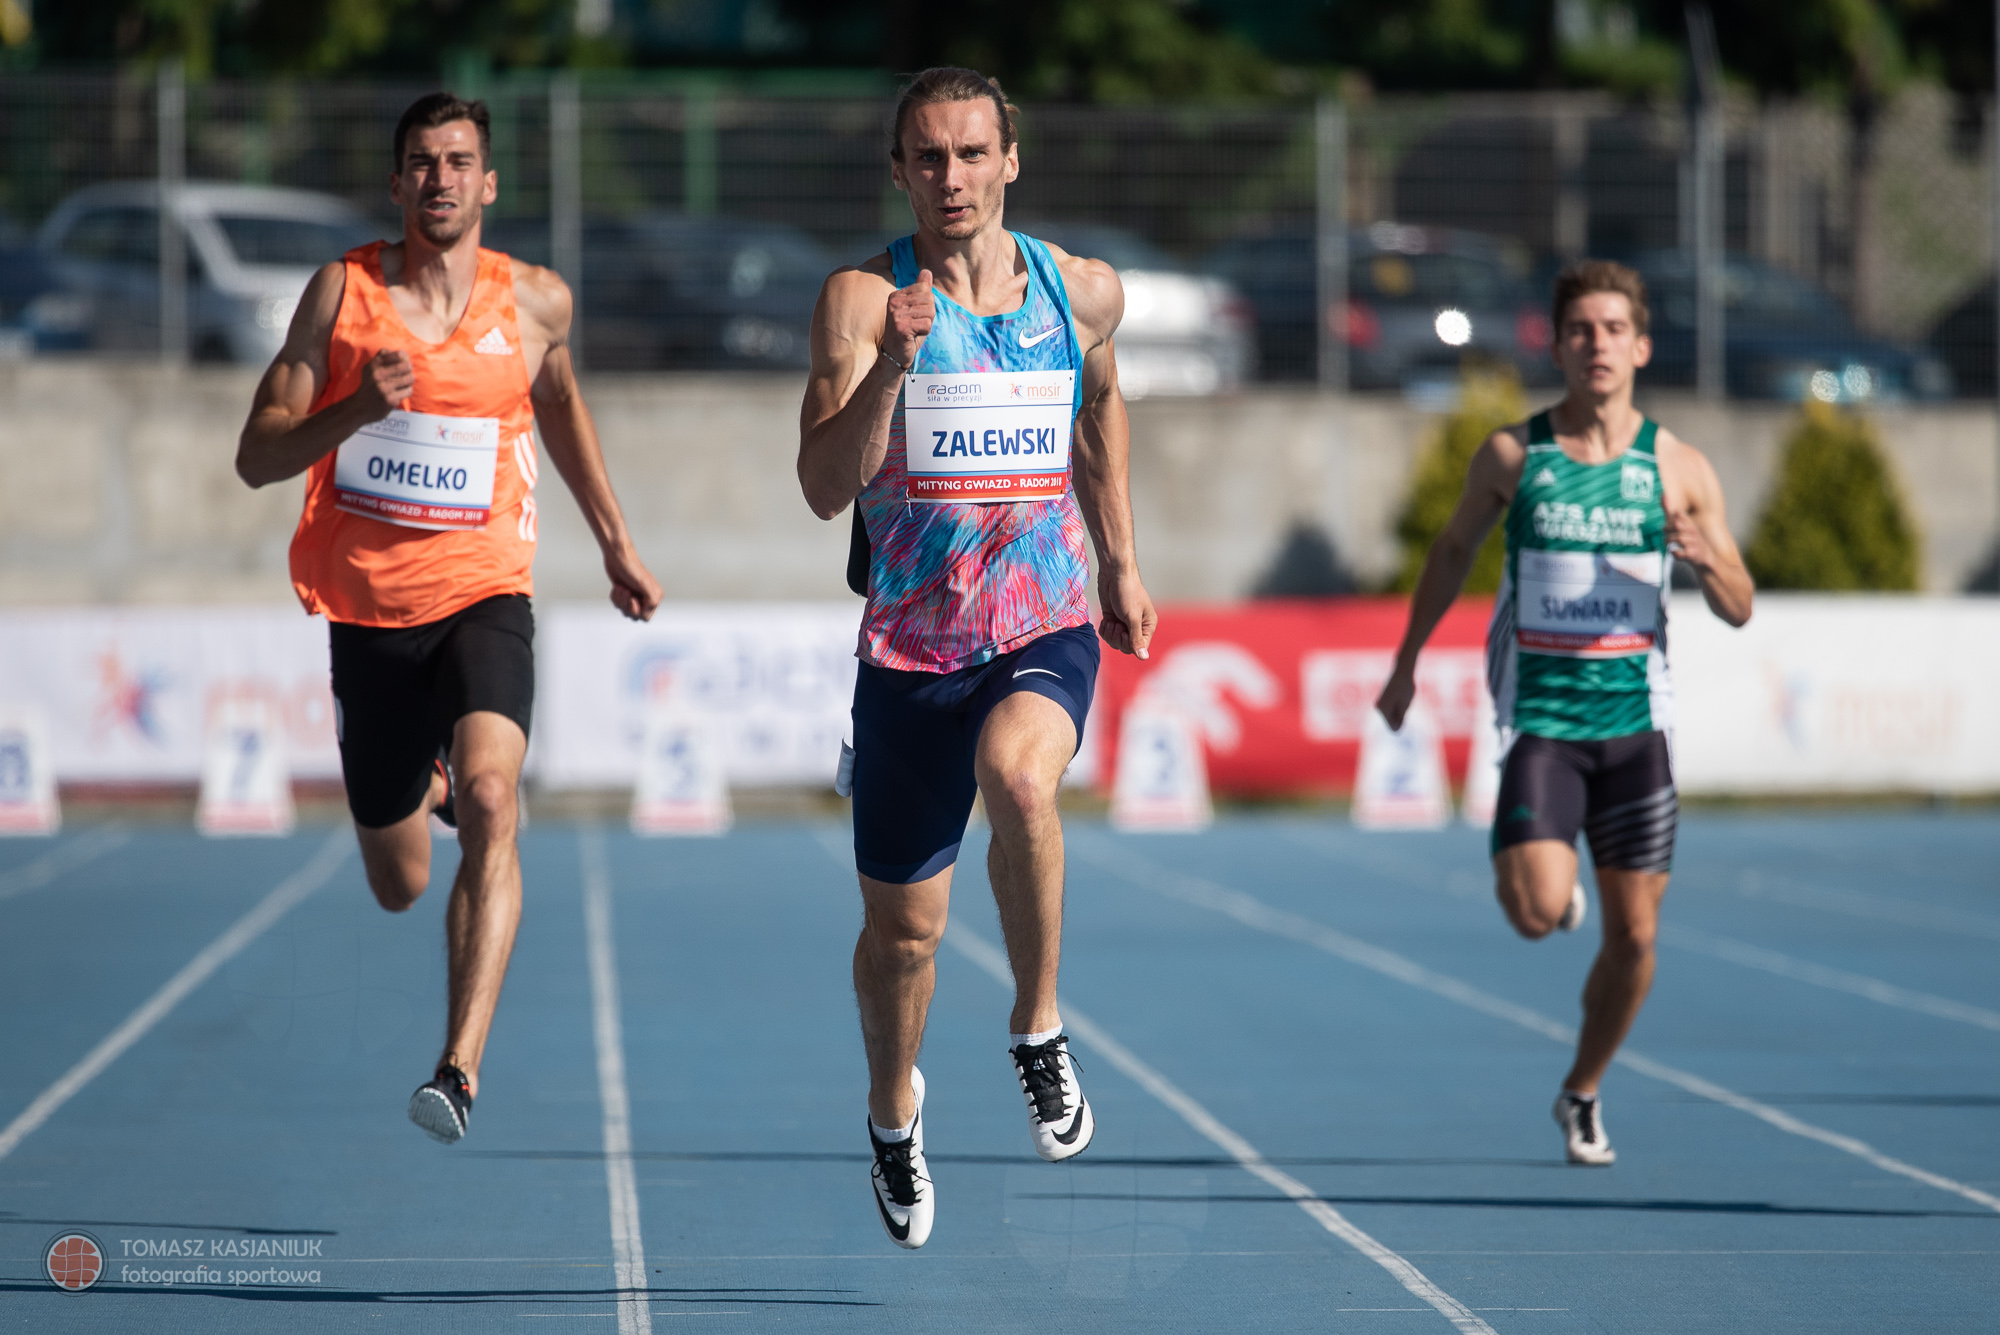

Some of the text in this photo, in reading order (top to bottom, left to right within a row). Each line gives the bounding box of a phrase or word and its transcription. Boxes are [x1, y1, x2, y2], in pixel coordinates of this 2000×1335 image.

[927, 384, 982, 395] radom
[953, 395, 983, 403] precyzji
[1027, 382, 1061, 397] mosir
[932, 428, 1055, 457] ZALEWSKI
[368, 456, 467, 490] OMELKO
[917, 480, 962, 491] MITYNG
[964, 479, 1011, 490] GWIAZD
[1020, 477, 1049, 488] RADOM
[1050, 476, 1063, 487] 2018
[341, 493, 379, 509] MITYNG
[380, 501, 423, 516] GWIAZD
[428, 508, 463, 520] RADOM
[1542, 597, 1632, 620] SUWARA
